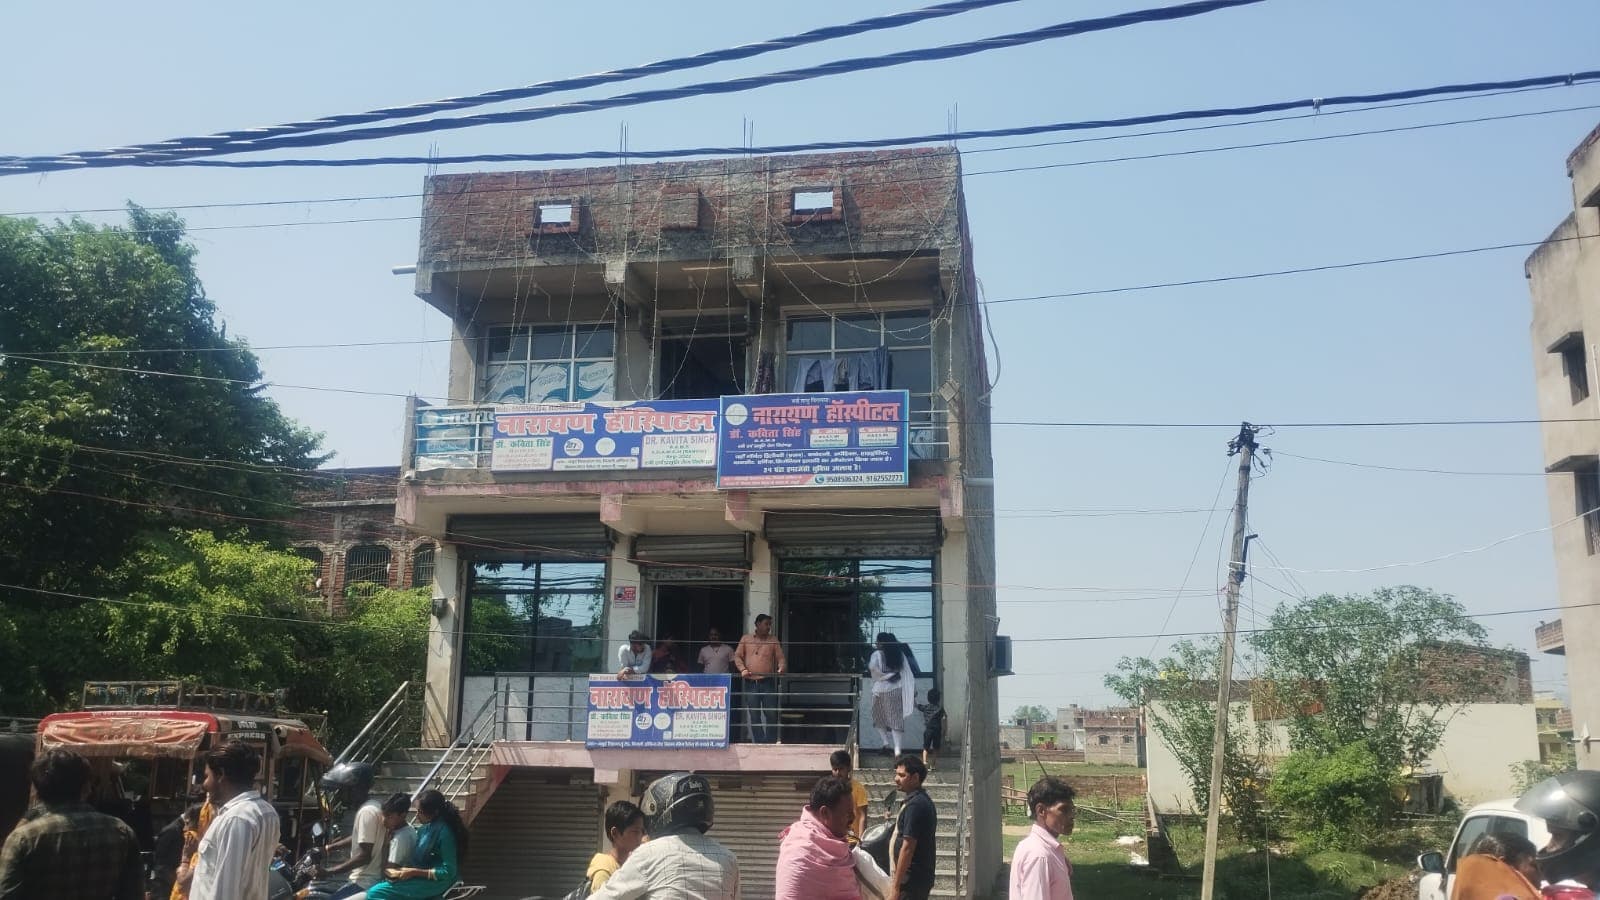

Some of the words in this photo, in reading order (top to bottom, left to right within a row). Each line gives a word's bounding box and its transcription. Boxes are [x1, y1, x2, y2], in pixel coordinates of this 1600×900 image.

[752, 405, 820, 425] नारायण
[825, 398, 901, 423] हॉस्पीटल
[495, 413, 598, 436] नारायण
[747, 427, 779, 438] कविता
[782, 426, 802, 437] सिंह
[645, 436, 658, 445] DR.
[660, 435, 690, 445] KAVITA
[690, 434, 715, 444] SINGH
[589, 687, 653, 709] नारायण
[657, 680, 728, 709] हॉस्पिटल
[227, 732, 266, 740] EXPRESS
